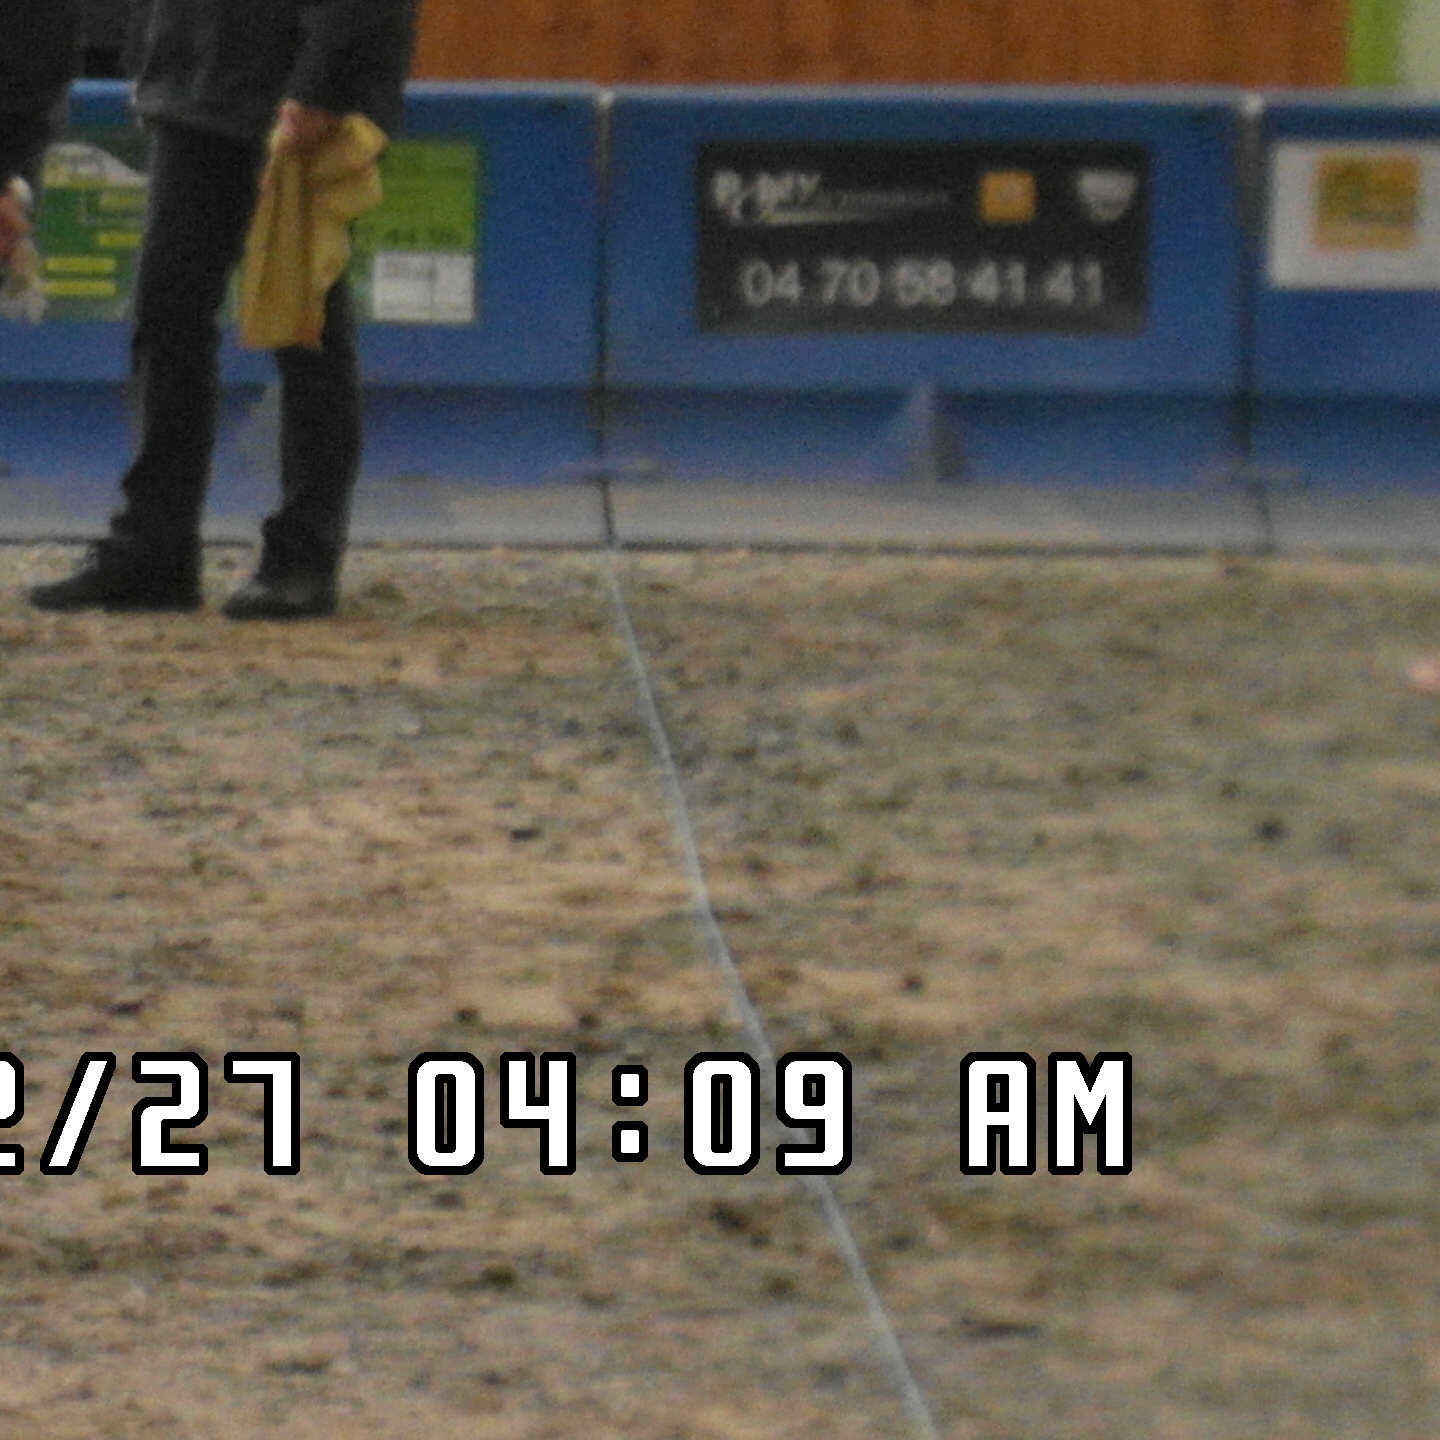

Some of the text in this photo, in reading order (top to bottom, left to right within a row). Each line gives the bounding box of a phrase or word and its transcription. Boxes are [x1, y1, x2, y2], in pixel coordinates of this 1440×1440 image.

[739, 262, 803, 307] 04
[819, 262, 881, 307] 70
[968, 262, 1028, 307] 41
[1043, 262, 1104, 307] 41
